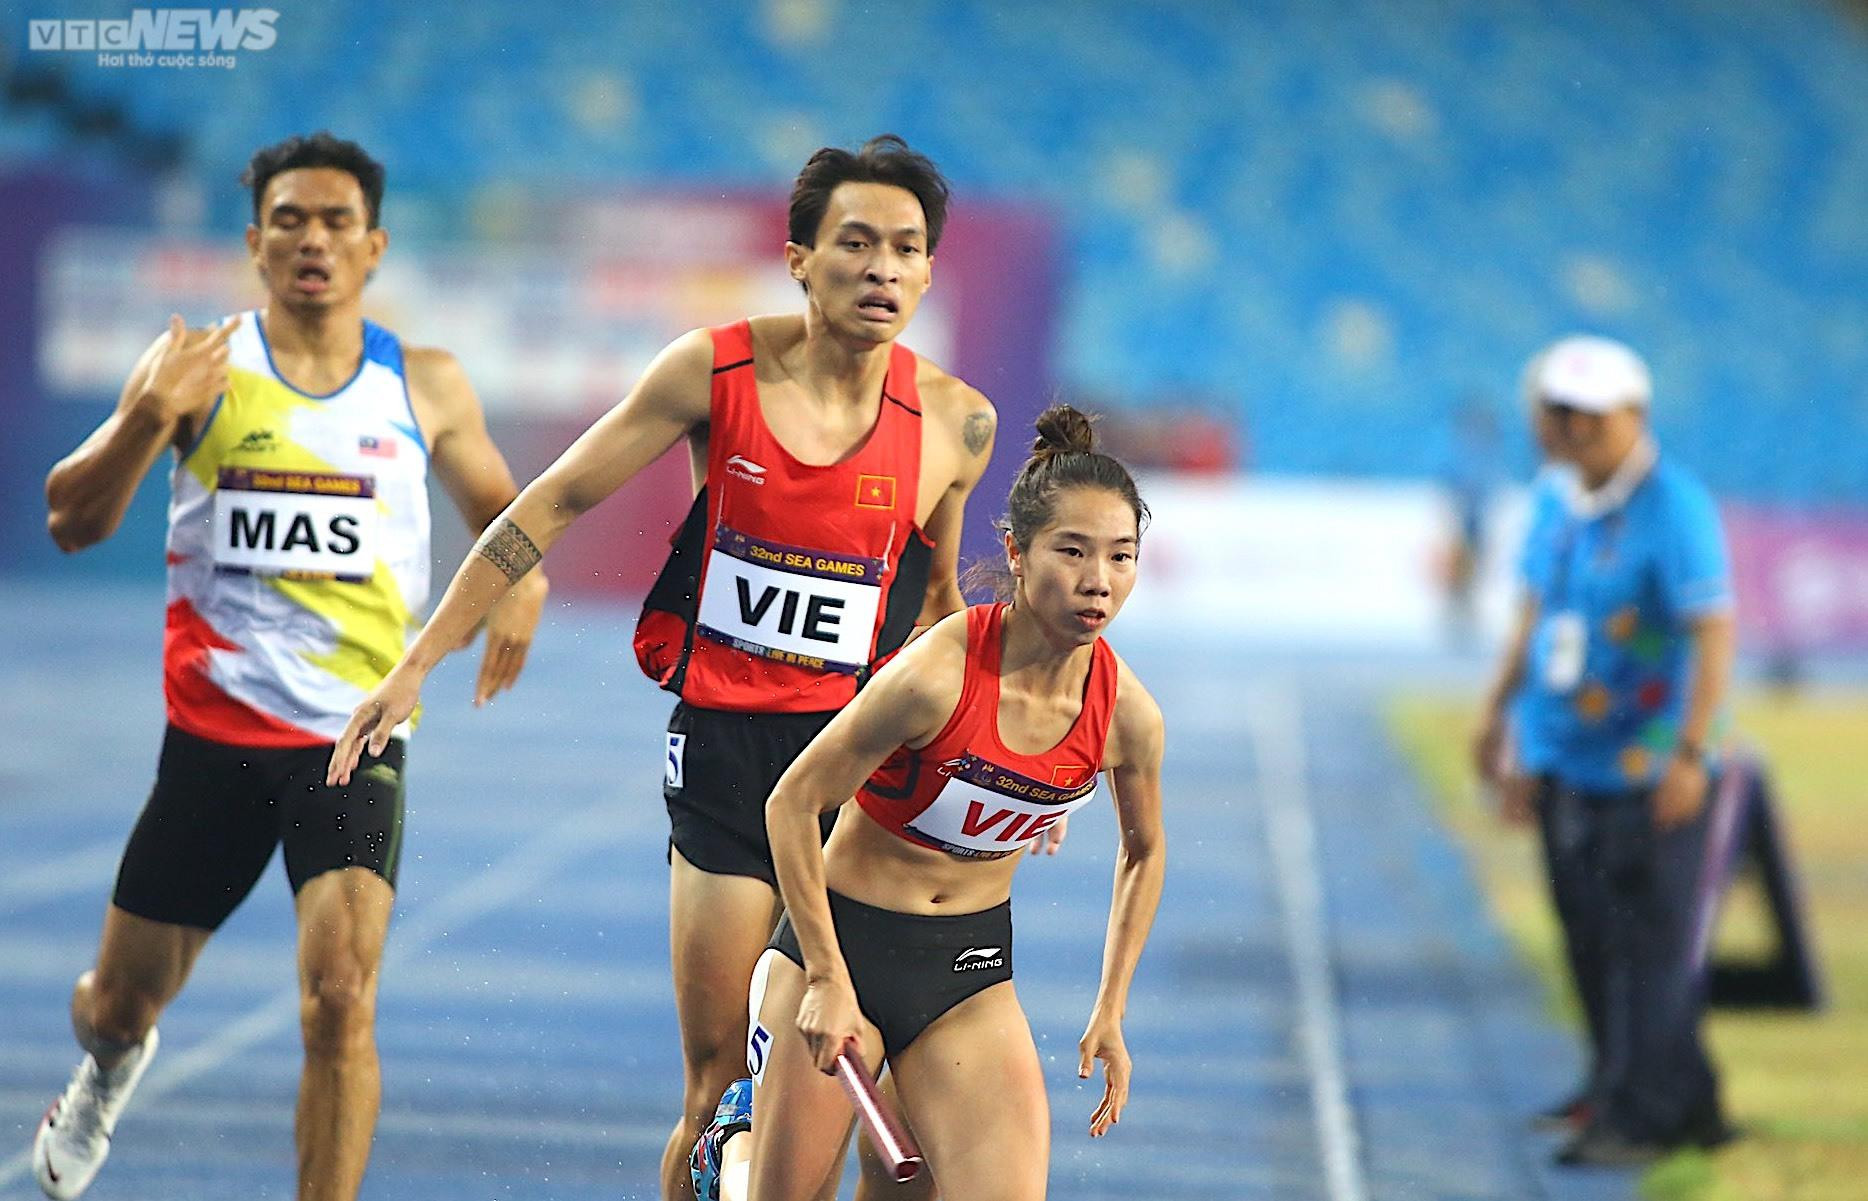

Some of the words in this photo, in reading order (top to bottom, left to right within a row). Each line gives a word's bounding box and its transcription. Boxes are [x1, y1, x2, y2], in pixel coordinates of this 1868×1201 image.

[230, 508, 359, 554] MAS
[750, 545, 783, 562] 32nd
[785, 553, 813, 568] SEA
[815, 558, 865, 576] GAMES
[736, 575, 846, 643] VIE
[669, 737, 680, 784] 5
[996, 775, 1029, 794] 32nd
[1030, 787, 1056, 800] SEA
[961, 800, 1069, 842] VIE
[953, 958, 1003, 971] LI-NING
[749, 1025, 770, 1076] 5
